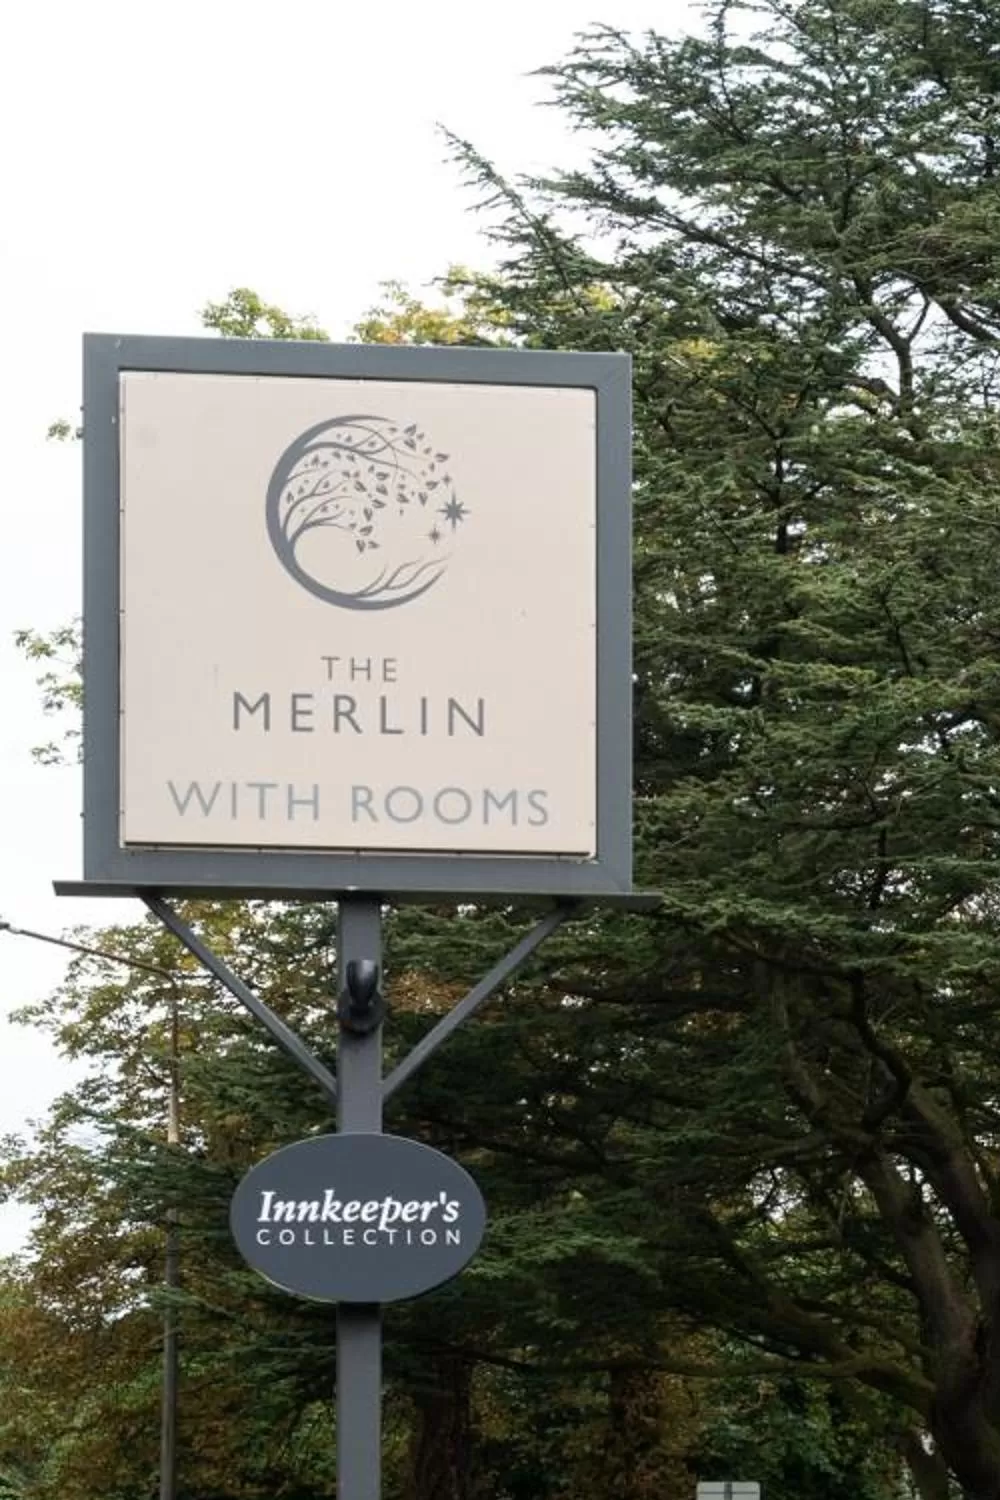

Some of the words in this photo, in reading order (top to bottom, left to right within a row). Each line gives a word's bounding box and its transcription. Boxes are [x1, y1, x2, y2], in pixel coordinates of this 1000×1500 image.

[320, 655, 398, 683] THE
[232, 691, 486, 737] MERLIN
[166, 780, 319, 822] WITH
[350, 784, 550, 827] ROOMS
[256, 1189, 461, 1231] Innkeeper's
[256, 1228, 461, 1245] COLLECTION
